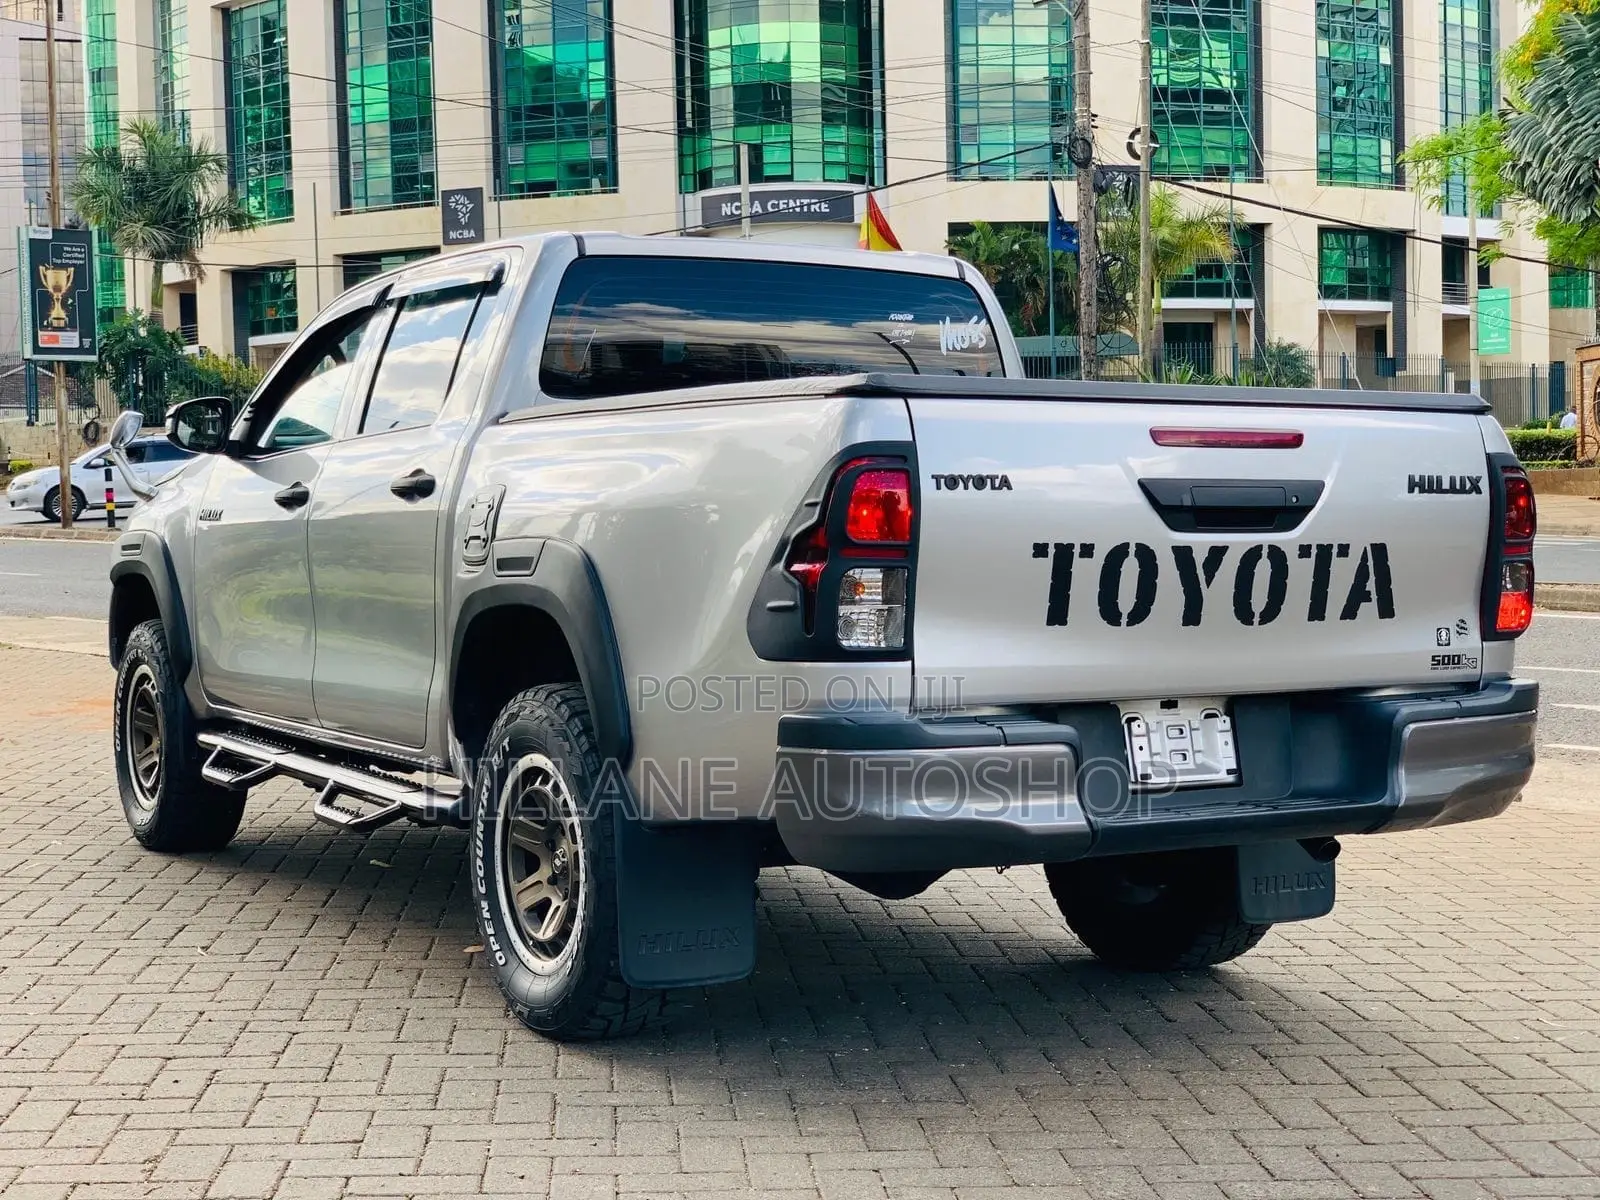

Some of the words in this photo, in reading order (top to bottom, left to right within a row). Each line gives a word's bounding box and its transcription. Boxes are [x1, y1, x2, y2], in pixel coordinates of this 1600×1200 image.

[721, 200, 763, 216] NCA
[767, 198, 830, 213] CENTRE
[449, 229, 476, 239] NCBA
[931, 474, 1013, 491] TOYOTA
[1407, 474, 1483, 494] HILUX
[1032, 542, 1395, 627] TOYOTA
[118, 648, 138, 698] COUNTRY
[476, 766, 492, 895] COUNTRY
[1251, 871, 1326, 896] HILUX
[480, 900, 506, 966] OPEN
[637, 926, 742, 957] HILUX
